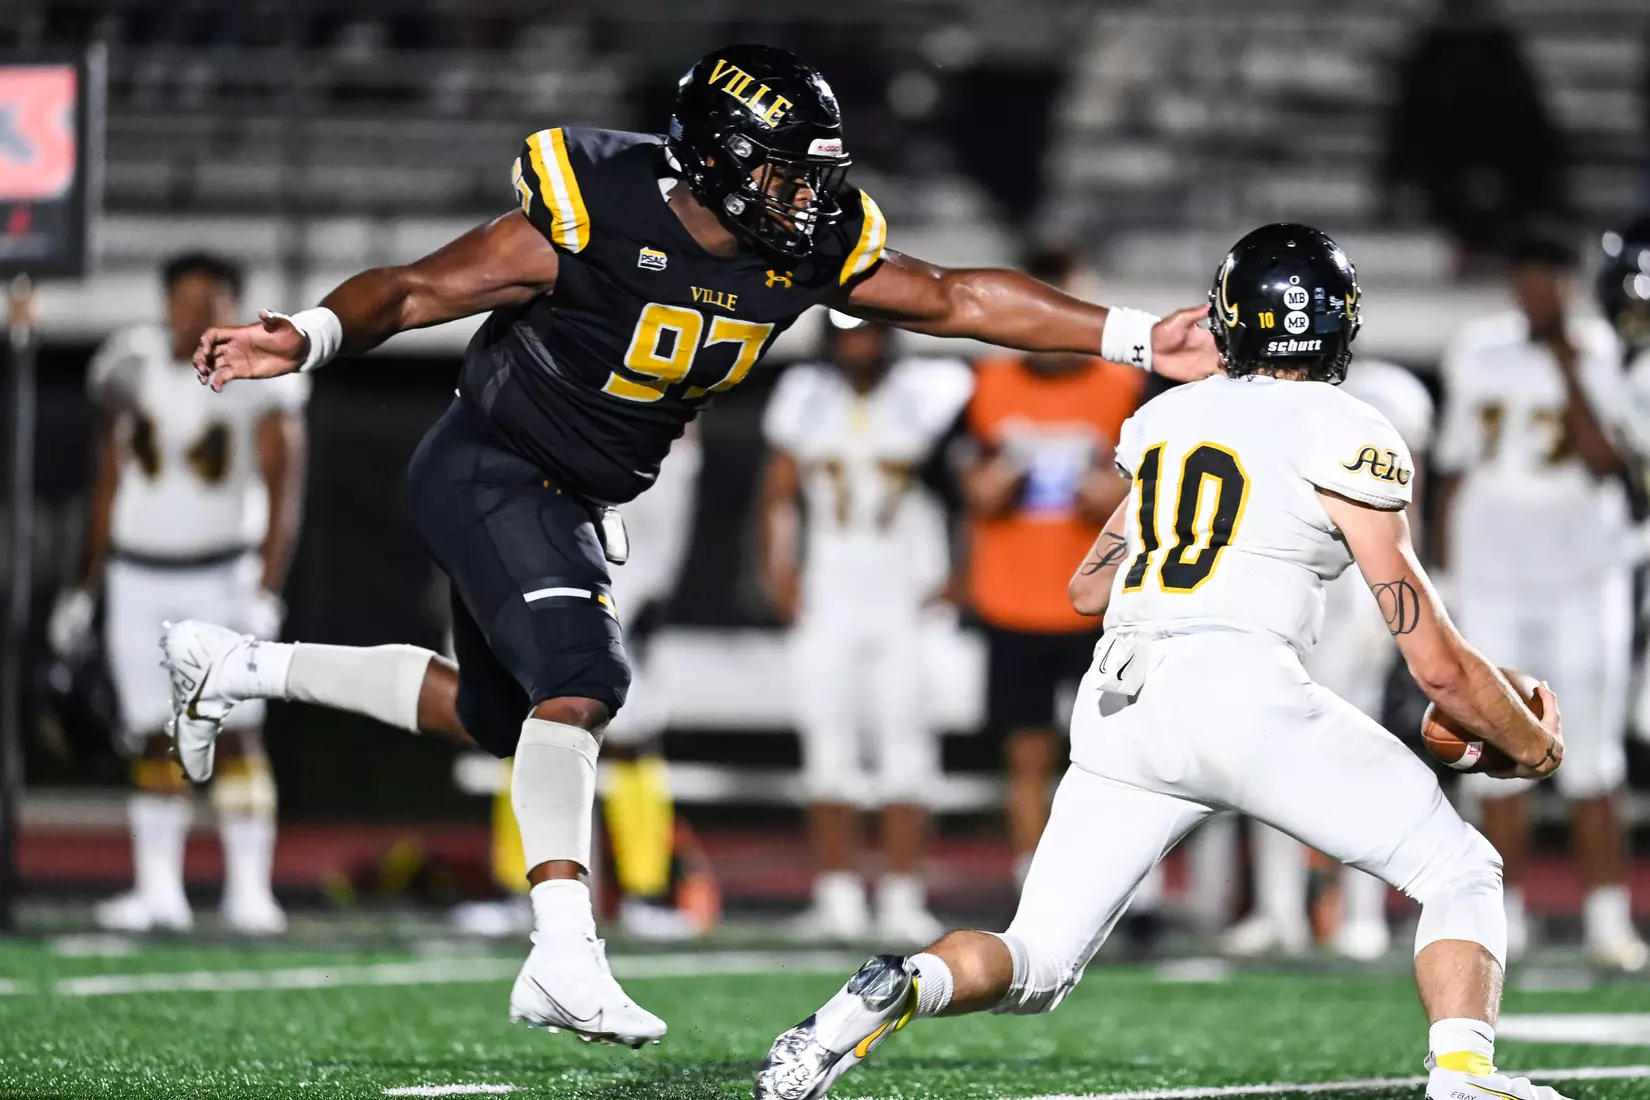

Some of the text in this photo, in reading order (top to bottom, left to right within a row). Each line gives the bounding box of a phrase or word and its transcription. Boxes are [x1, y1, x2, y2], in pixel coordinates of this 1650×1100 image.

[707, 59, 793, 128] VILLE
[641, 254, 664, 265] PSAC
[690, 285, 738, 311] VILLE
[1288, 292, 1305, 304] MB
[1258, 311, 1274, 329] 10
[1288, 316, 1306, 328] MR
[602, 303, 776, 402] 97
[1267, 339, 1322, 352] schutt
[1122, 441, 1251, 594] 10
